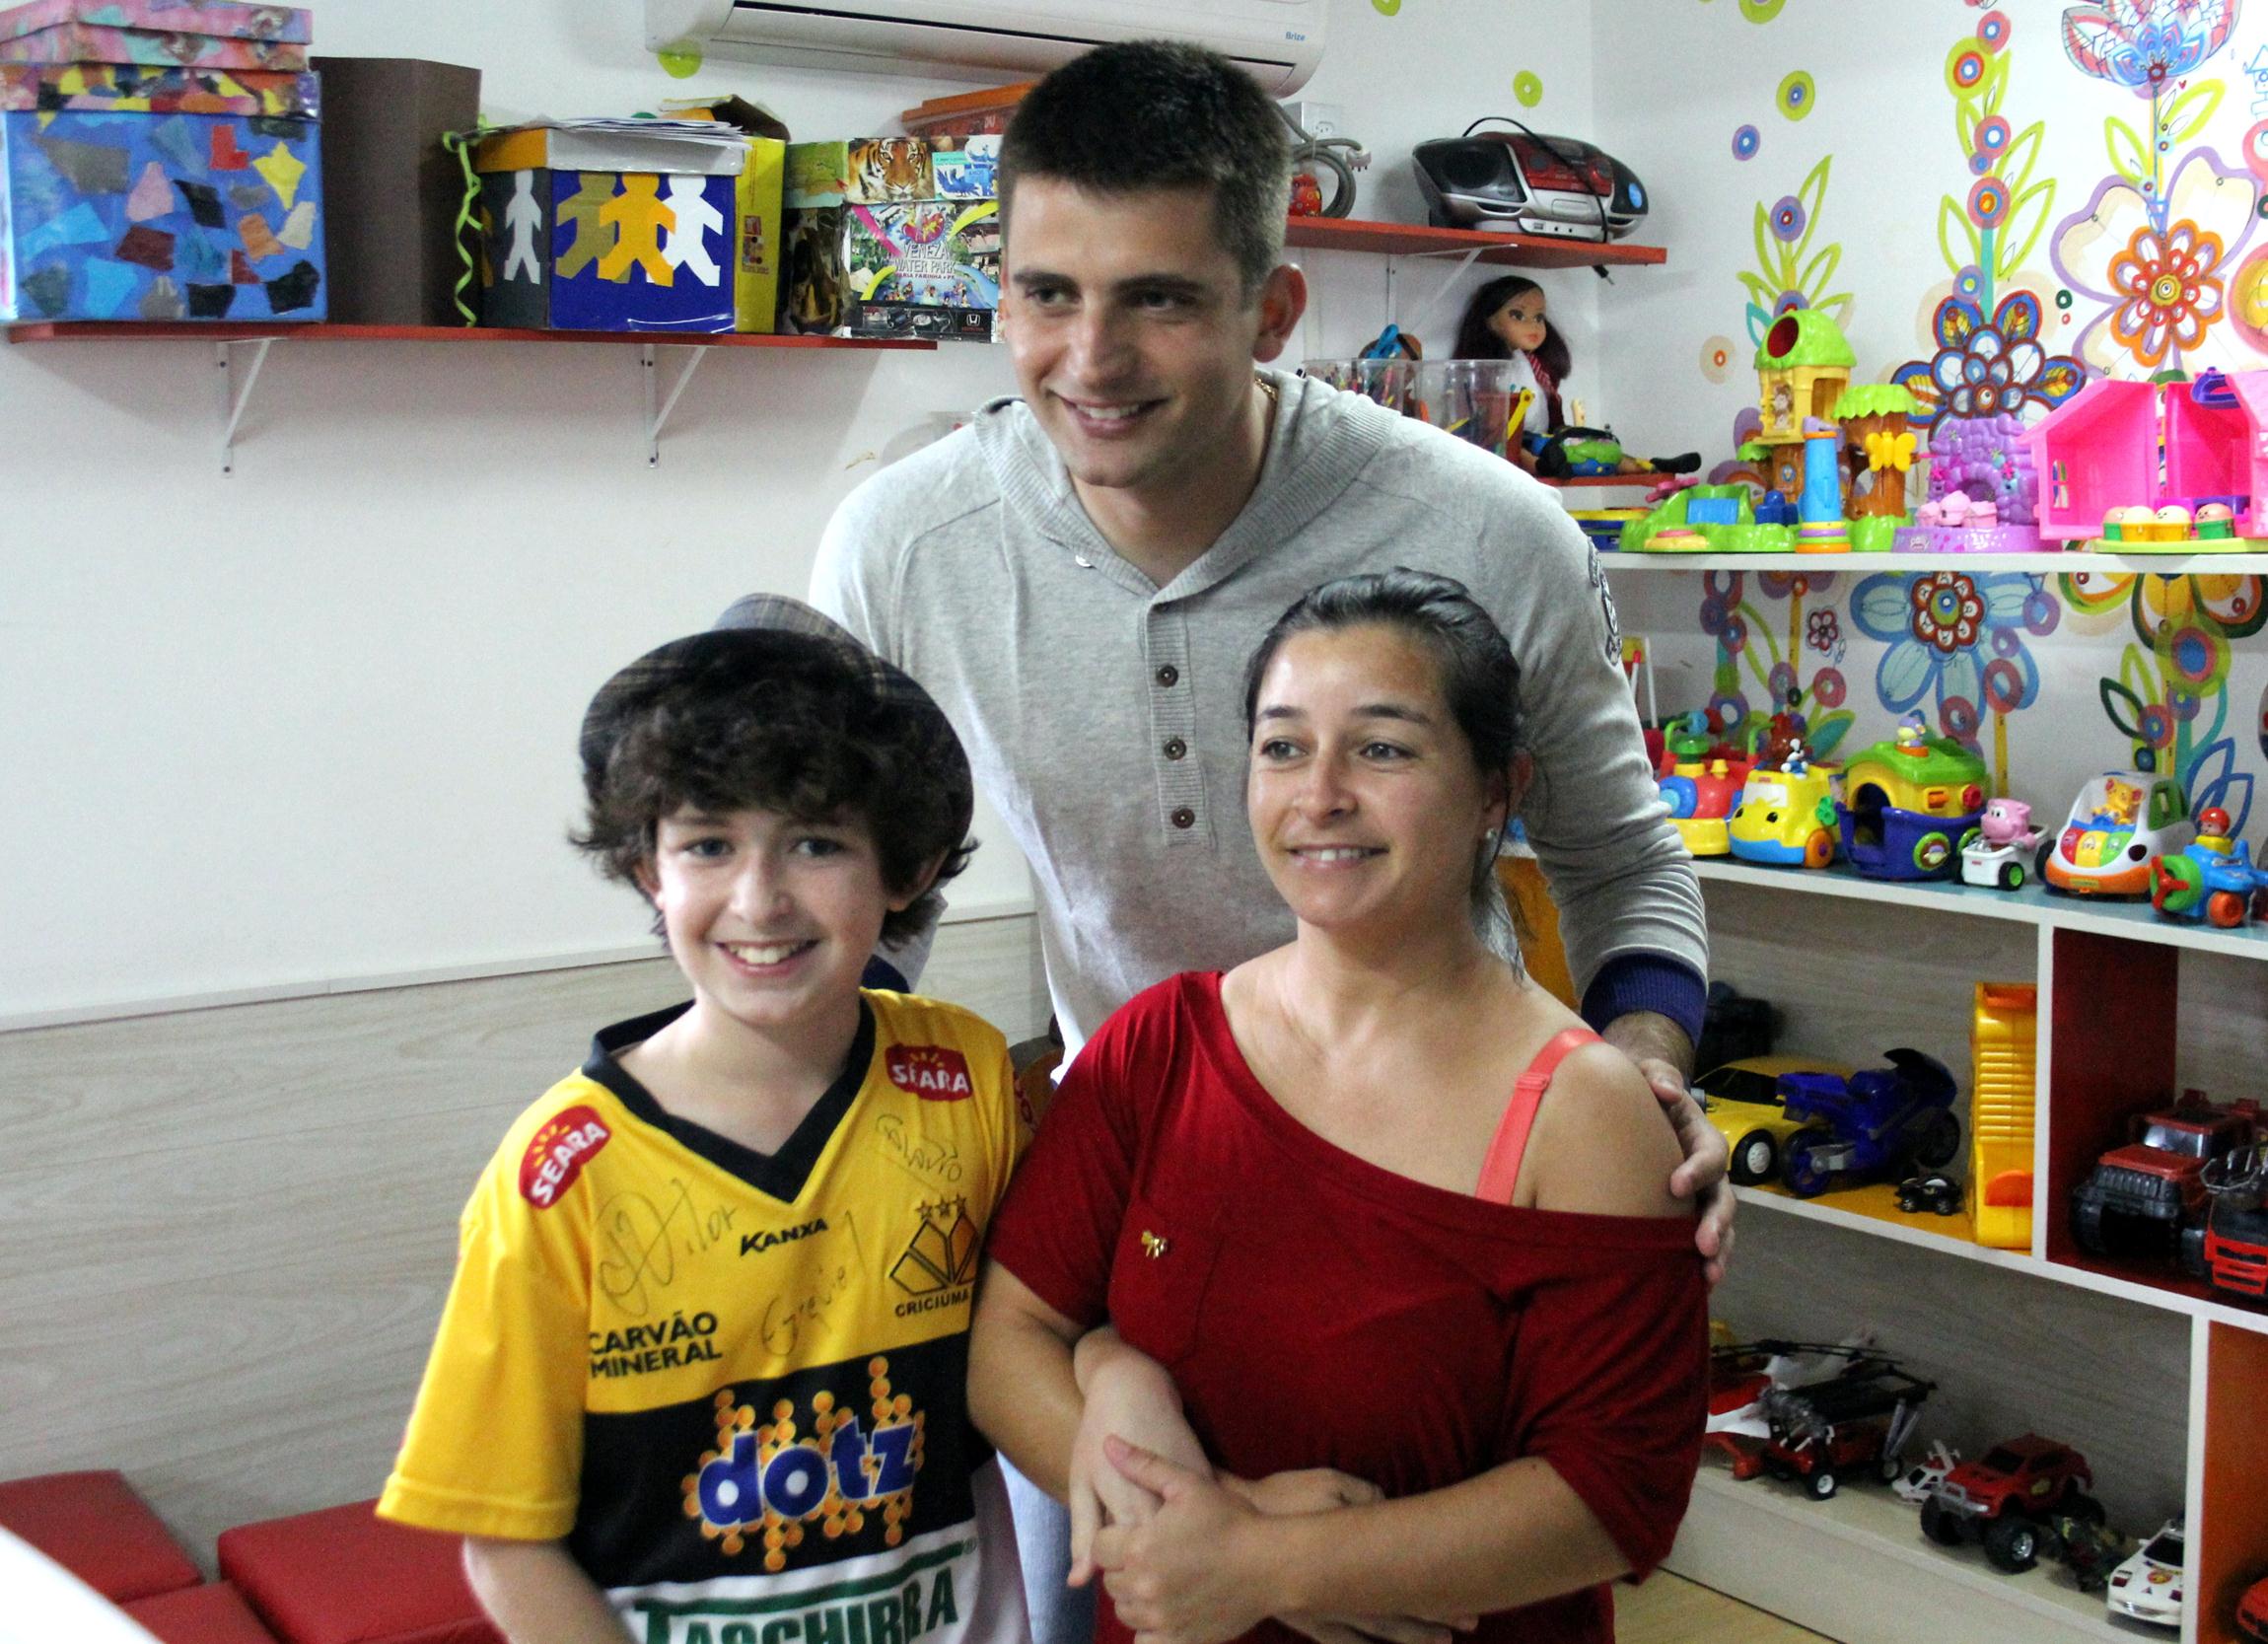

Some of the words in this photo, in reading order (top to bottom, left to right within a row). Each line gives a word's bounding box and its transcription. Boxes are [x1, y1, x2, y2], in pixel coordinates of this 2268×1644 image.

[894, 259, 929, 273] WATER
[930, 260, 957, 274] PARK
[903, 242, 951, 260] VENEZA
[531, 1121, 608, 1205] SEARA
[740, 1217, 828, 1257] KANXA
[590, 1310, 719, 1356] CARVÃO
[592, 1338, 724, 1379] MINERAL
[698, 1414, 917, 1528] dotz
